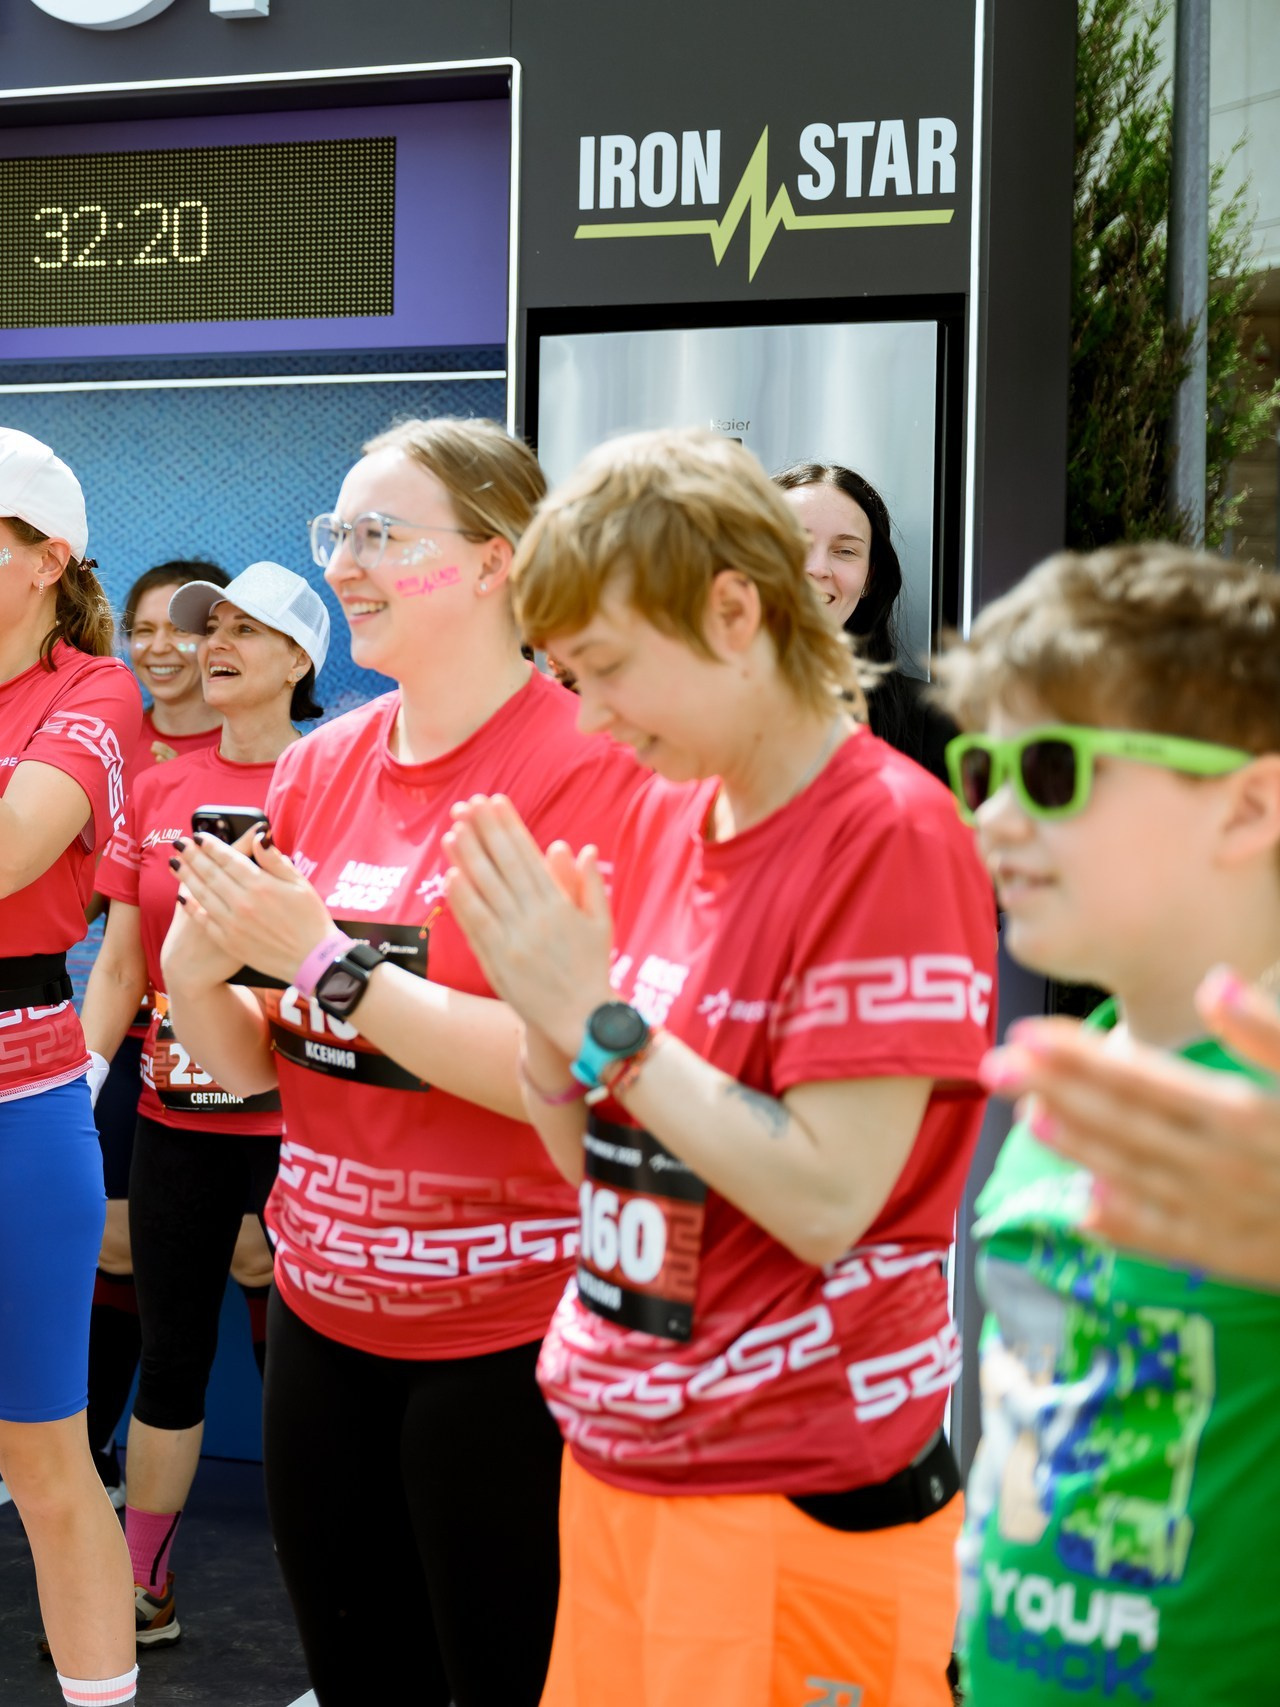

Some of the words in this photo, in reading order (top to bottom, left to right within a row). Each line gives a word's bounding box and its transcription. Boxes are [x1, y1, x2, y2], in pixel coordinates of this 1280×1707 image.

[579, 130, 720, 210] IRON
[798, 117, 958, 200] STAR
[34, 200, 208, 269] 32:20
[305, 1040, 357, 1070] КСЕНИЯ
[190, 1092, 244, 1104] СВЕТЛАНА
